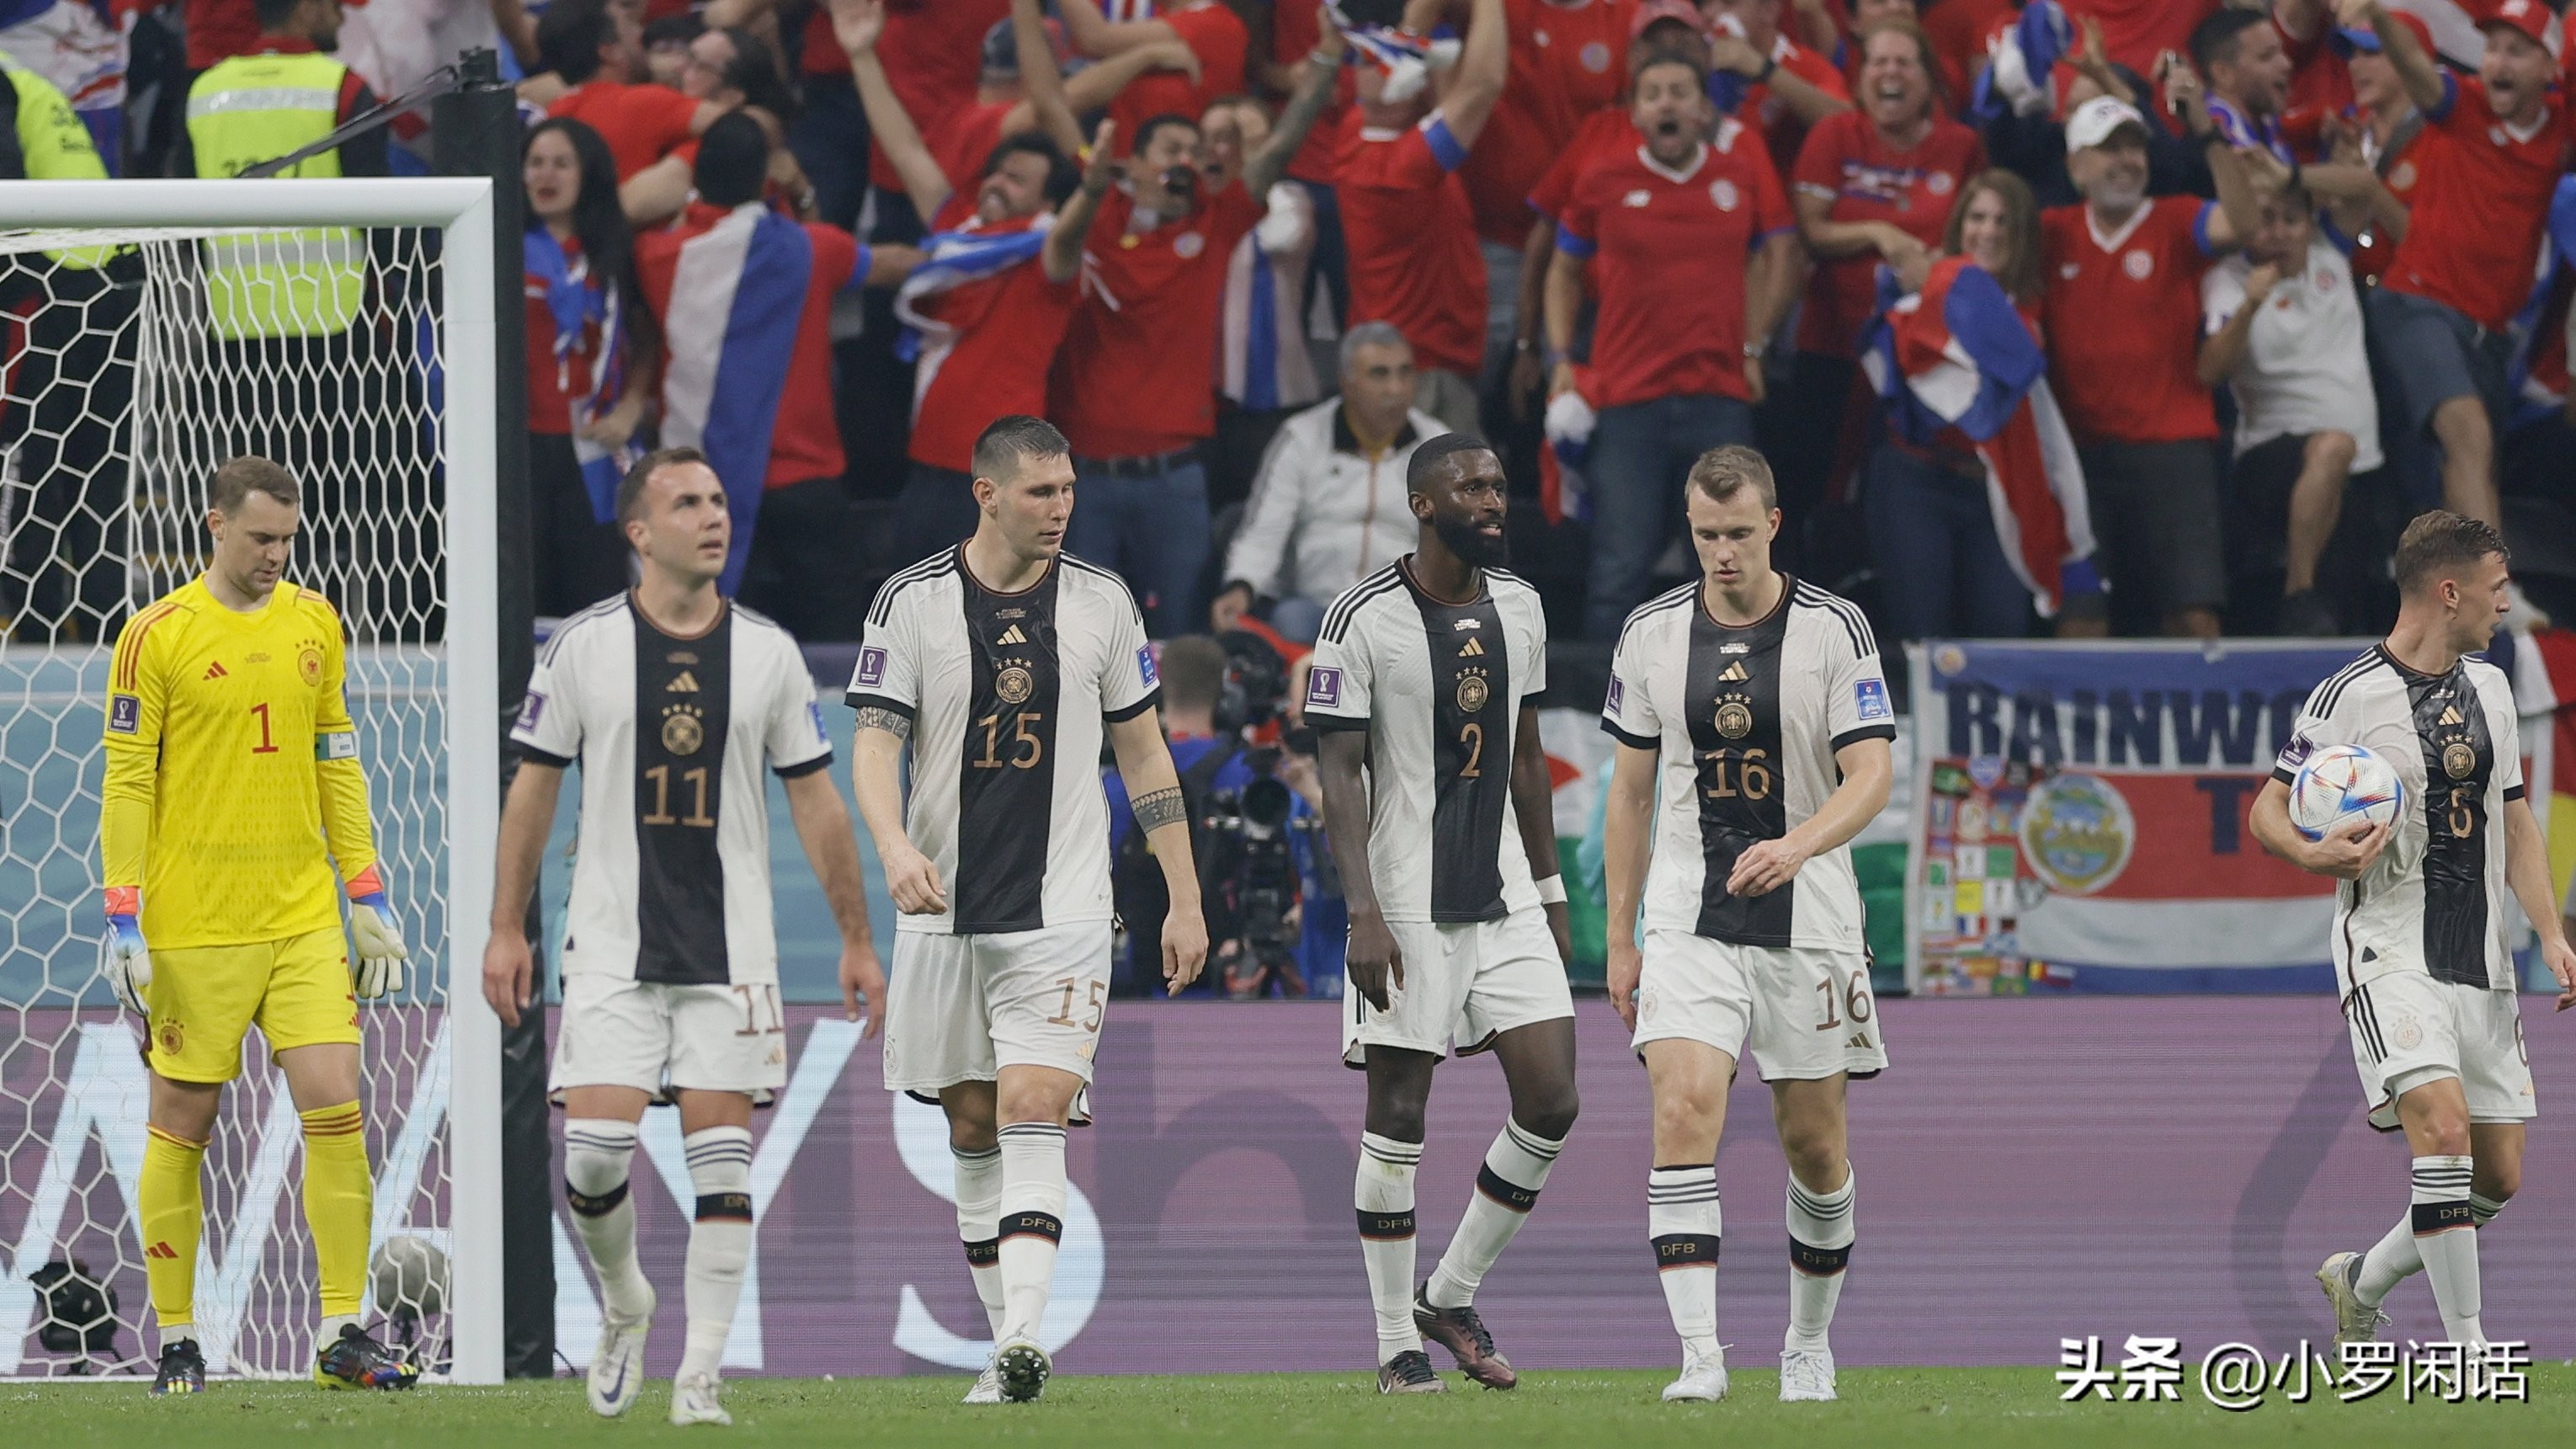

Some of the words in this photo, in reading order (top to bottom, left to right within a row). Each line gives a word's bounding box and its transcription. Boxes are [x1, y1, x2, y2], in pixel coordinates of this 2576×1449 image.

[251, 702, 279, 754] 1
[973, 713, 1041, 768] 15
[1460, 722, 1482, 776] 2
[643, 764, 714, 828] 11
[1705, 748, 1770, 801] 16
[2449, 787, 2472, 839] 6
[733, 983, 785, 1036] 11
[1047, 977, 1105, 1034] 15
[1816, 970, 1871, 1031] 16
[1020, 1217, 1056, 1232] DFB
[1378, 1217, 1411, 1229] DFB
[2440, 1207, 2469, 1219] DFB
[1661, 1243, 1695, 1256] DFB
[1802, 1251, 1839, 1265] DFB
